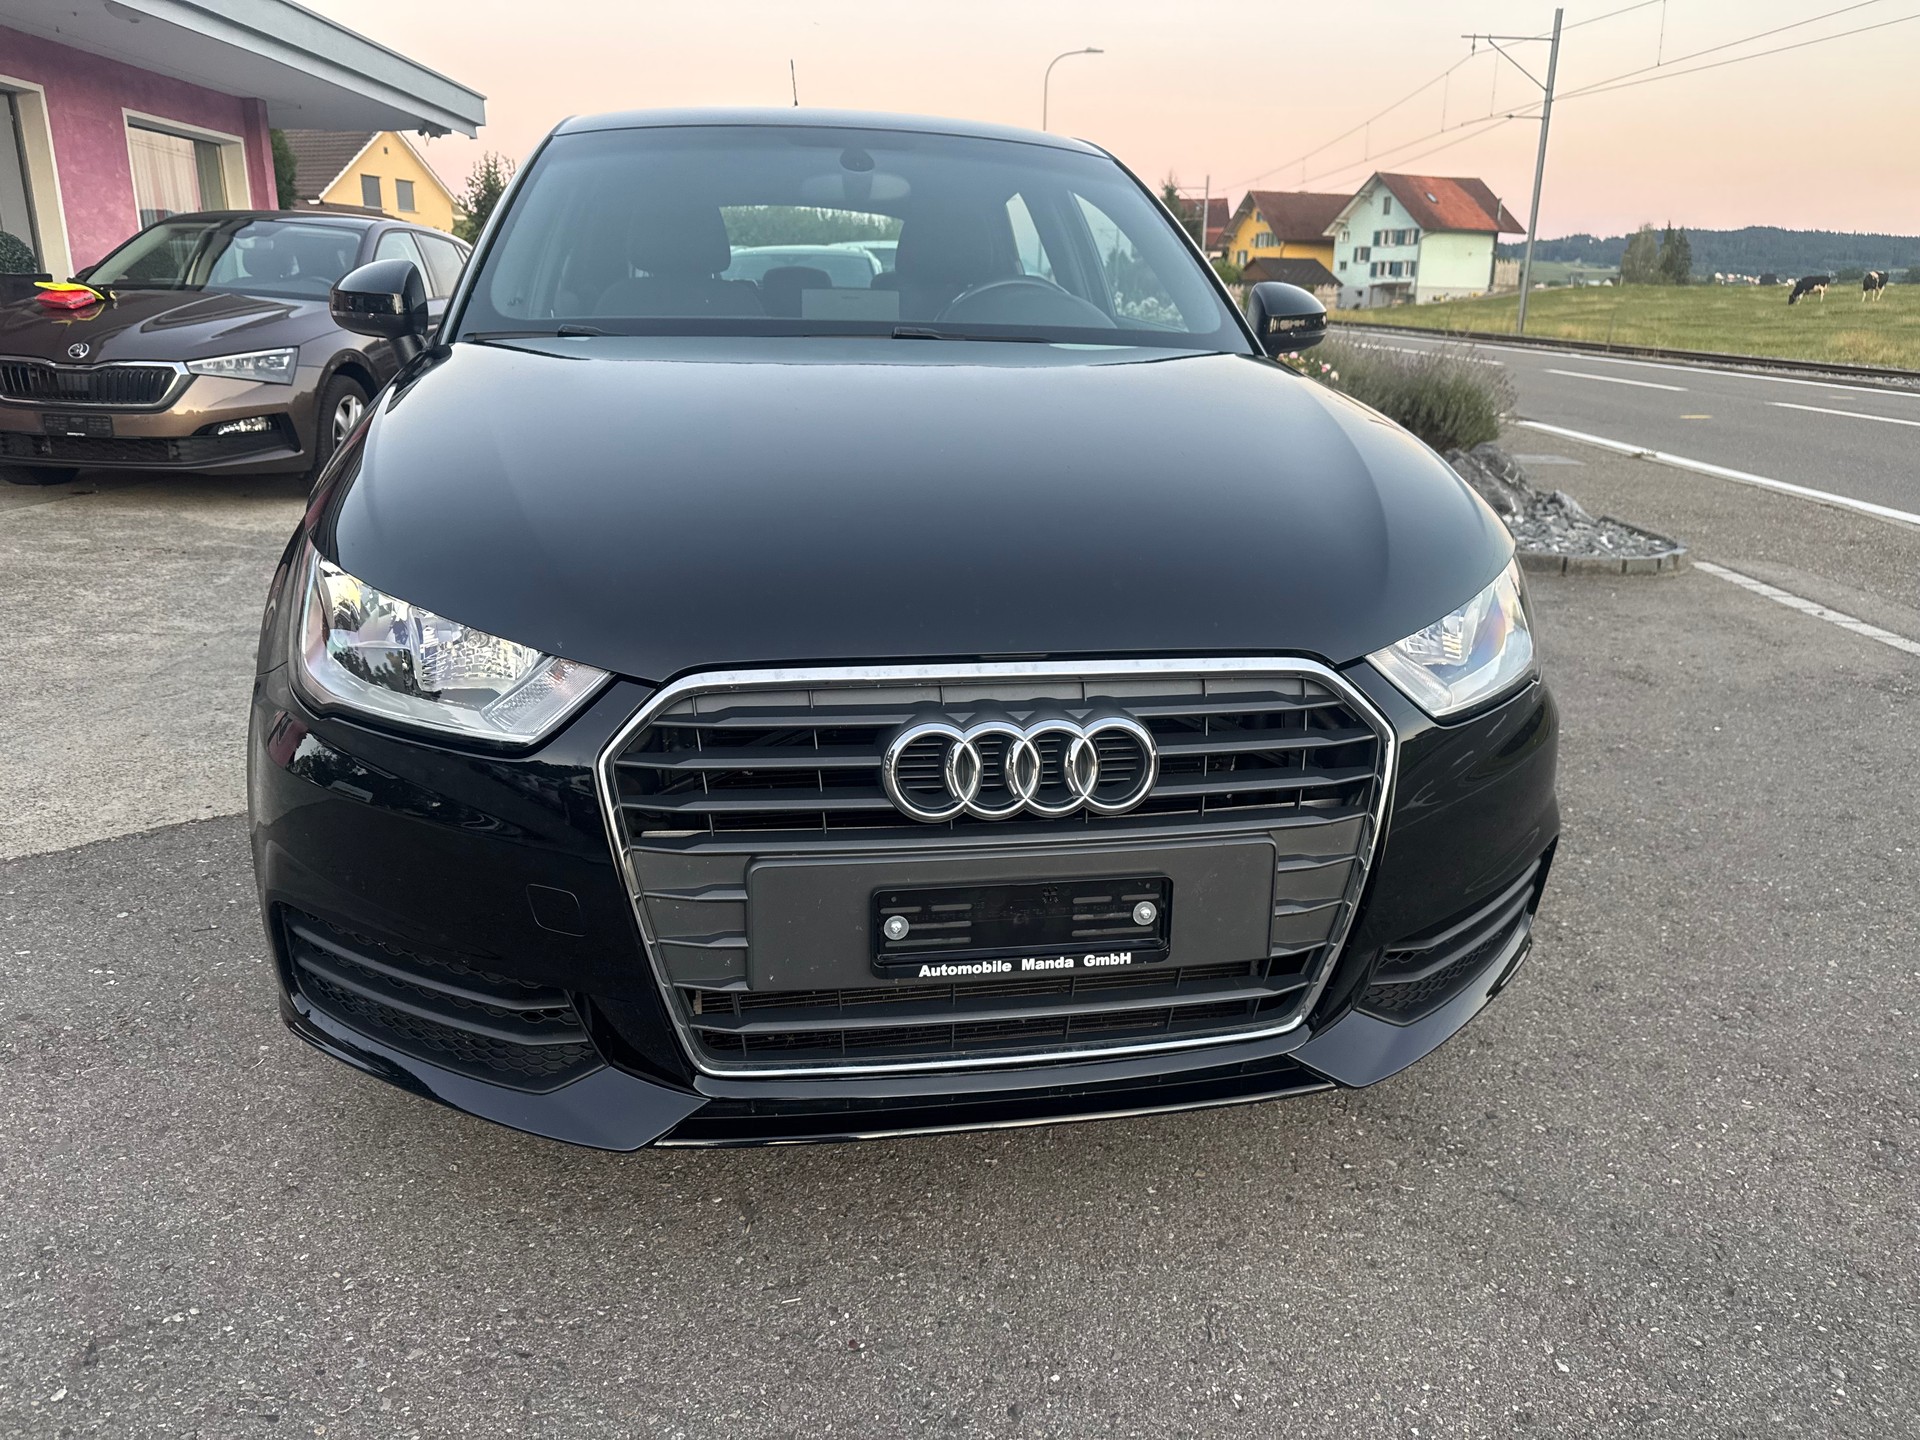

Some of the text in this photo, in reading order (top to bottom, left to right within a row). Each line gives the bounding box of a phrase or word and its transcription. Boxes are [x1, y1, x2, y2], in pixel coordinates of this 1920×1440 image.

[919, 952, 1132, 977] Automobile Manda GmbH
